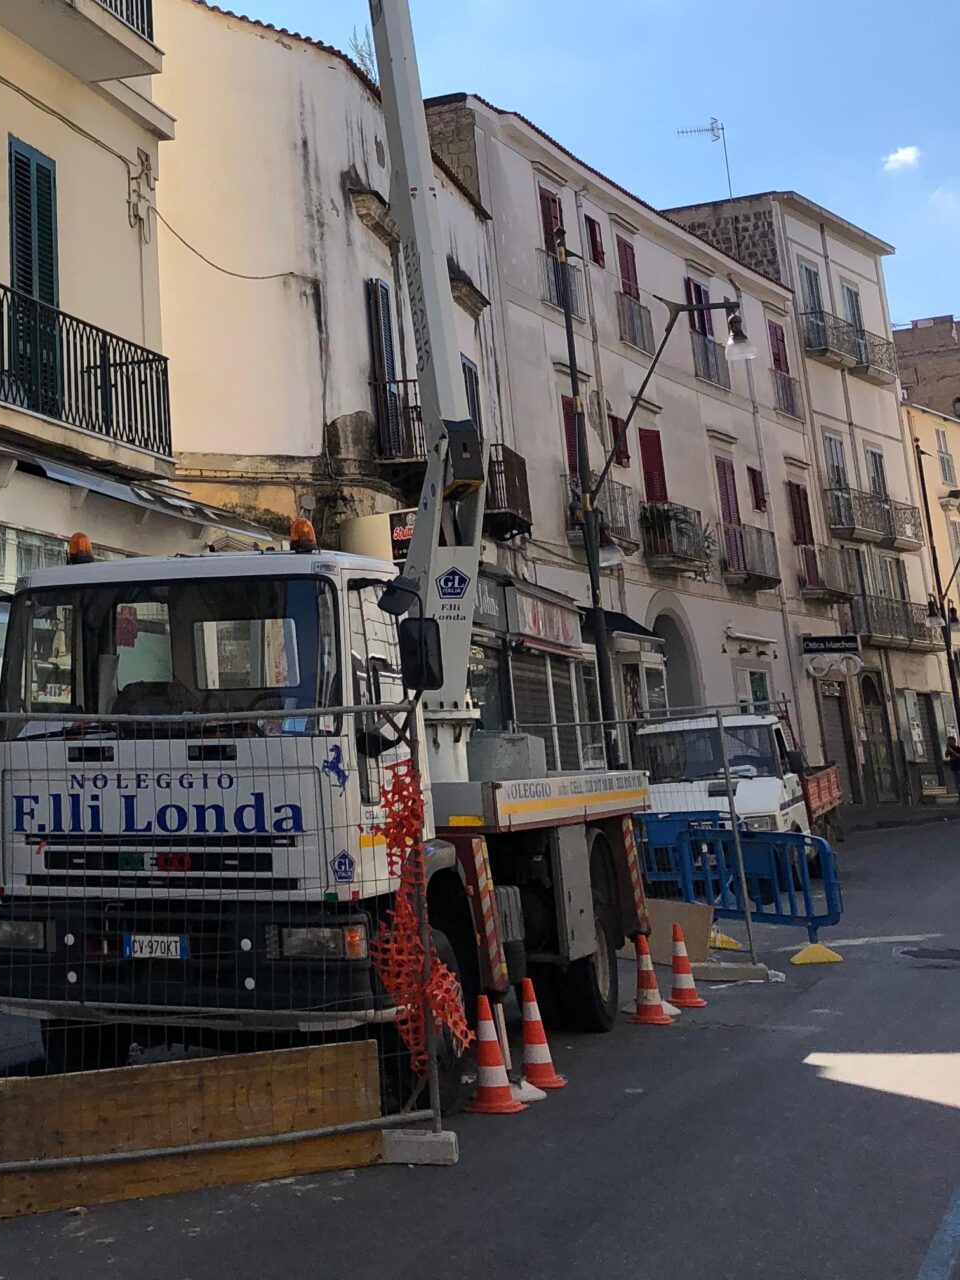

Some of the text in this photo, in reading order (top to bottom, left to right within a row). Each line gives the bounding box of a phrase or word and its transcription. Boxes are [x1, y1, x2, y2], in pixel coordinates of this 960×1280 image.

[440, 575, 465, 588] GL
[432, 613, 466, 621] Londa
[70, 773, 235, 790] NOLEGGIO
[12, 792, 307, 834] F.lli Londa
[334, 858, 354, 872] GL
[132, 939, 180, 956] CV 970KT
